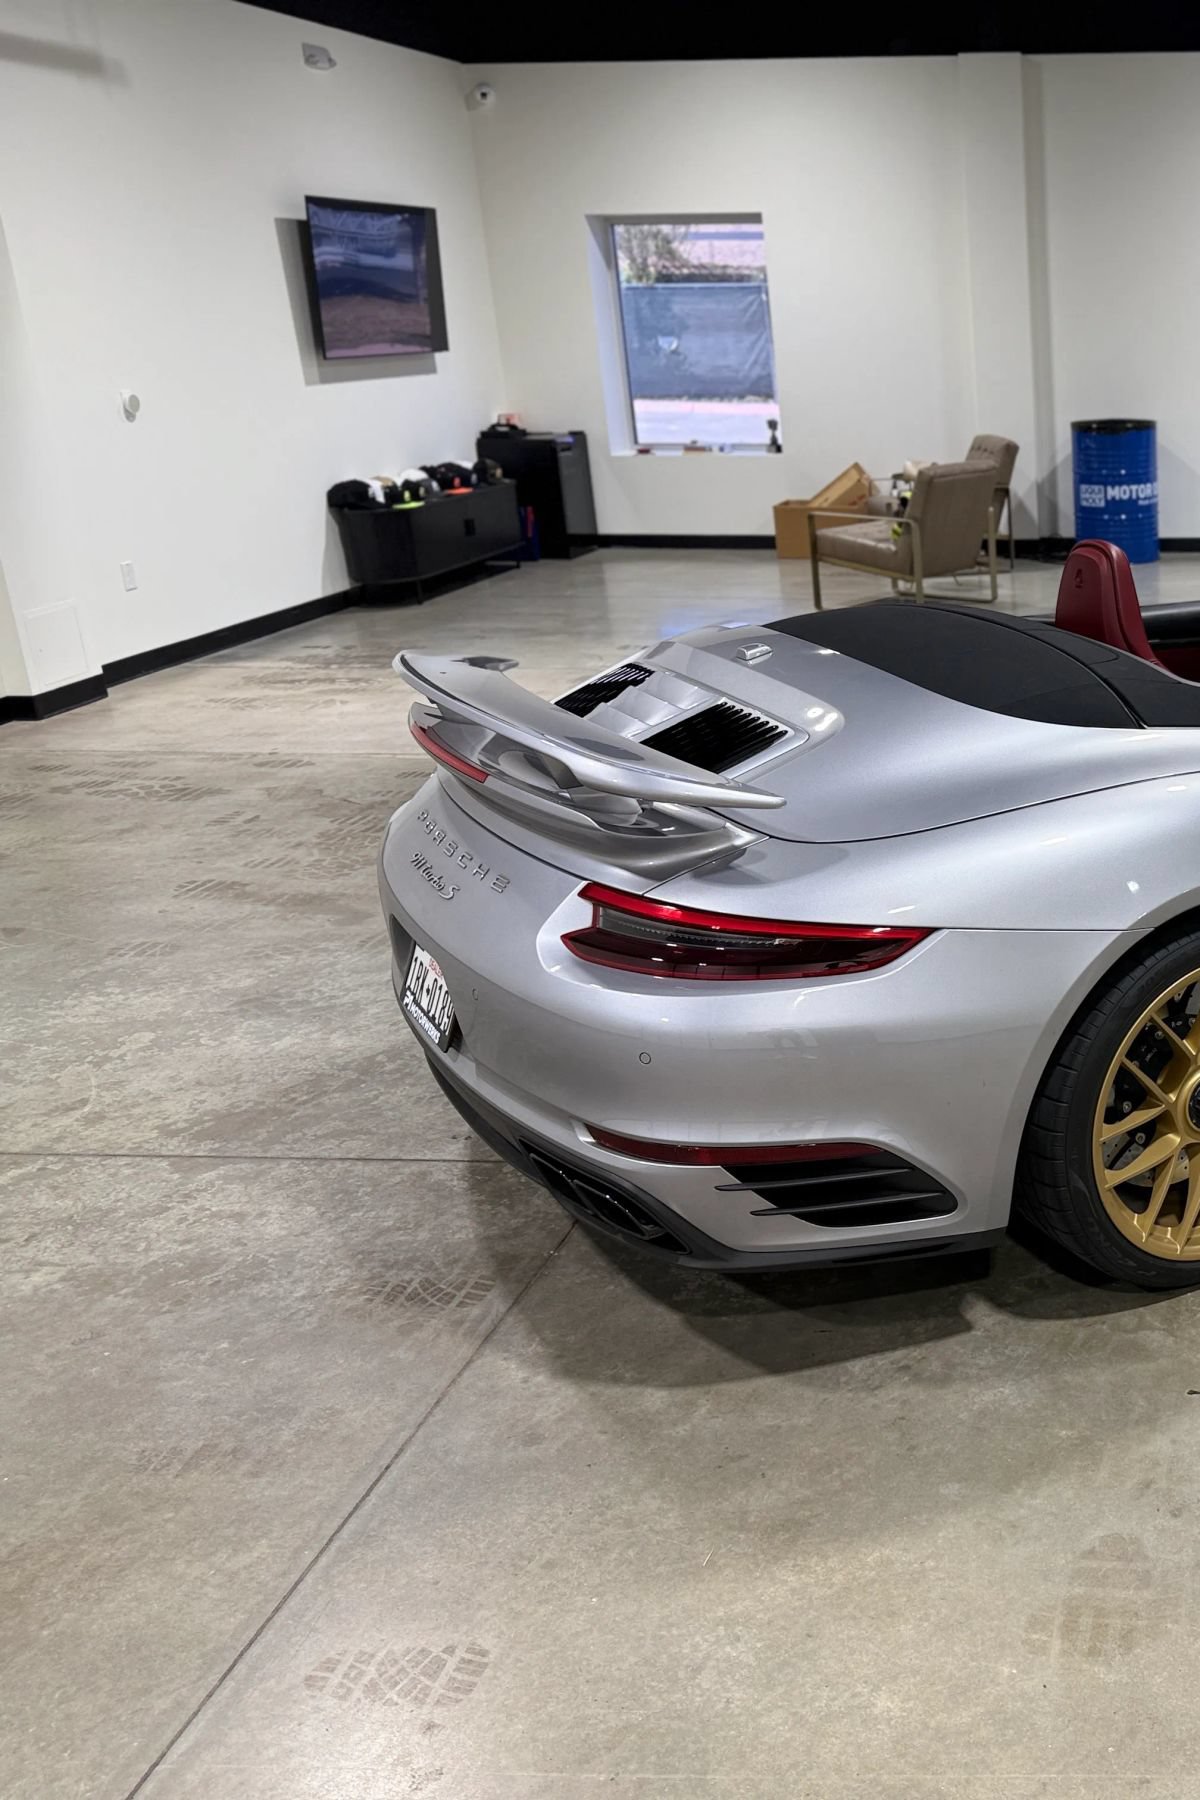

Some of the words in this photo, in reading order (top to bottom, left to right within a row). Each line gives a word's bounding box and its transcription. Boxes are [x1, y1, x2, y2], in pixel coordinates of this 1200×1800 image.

[1106, 483, 1152, 501] MOTOR
[410, 851, 428, 870] 911
[417, 809, 511, 894] PORSCHE
[410, 1001, 441, 1044] MOTORWERKS
